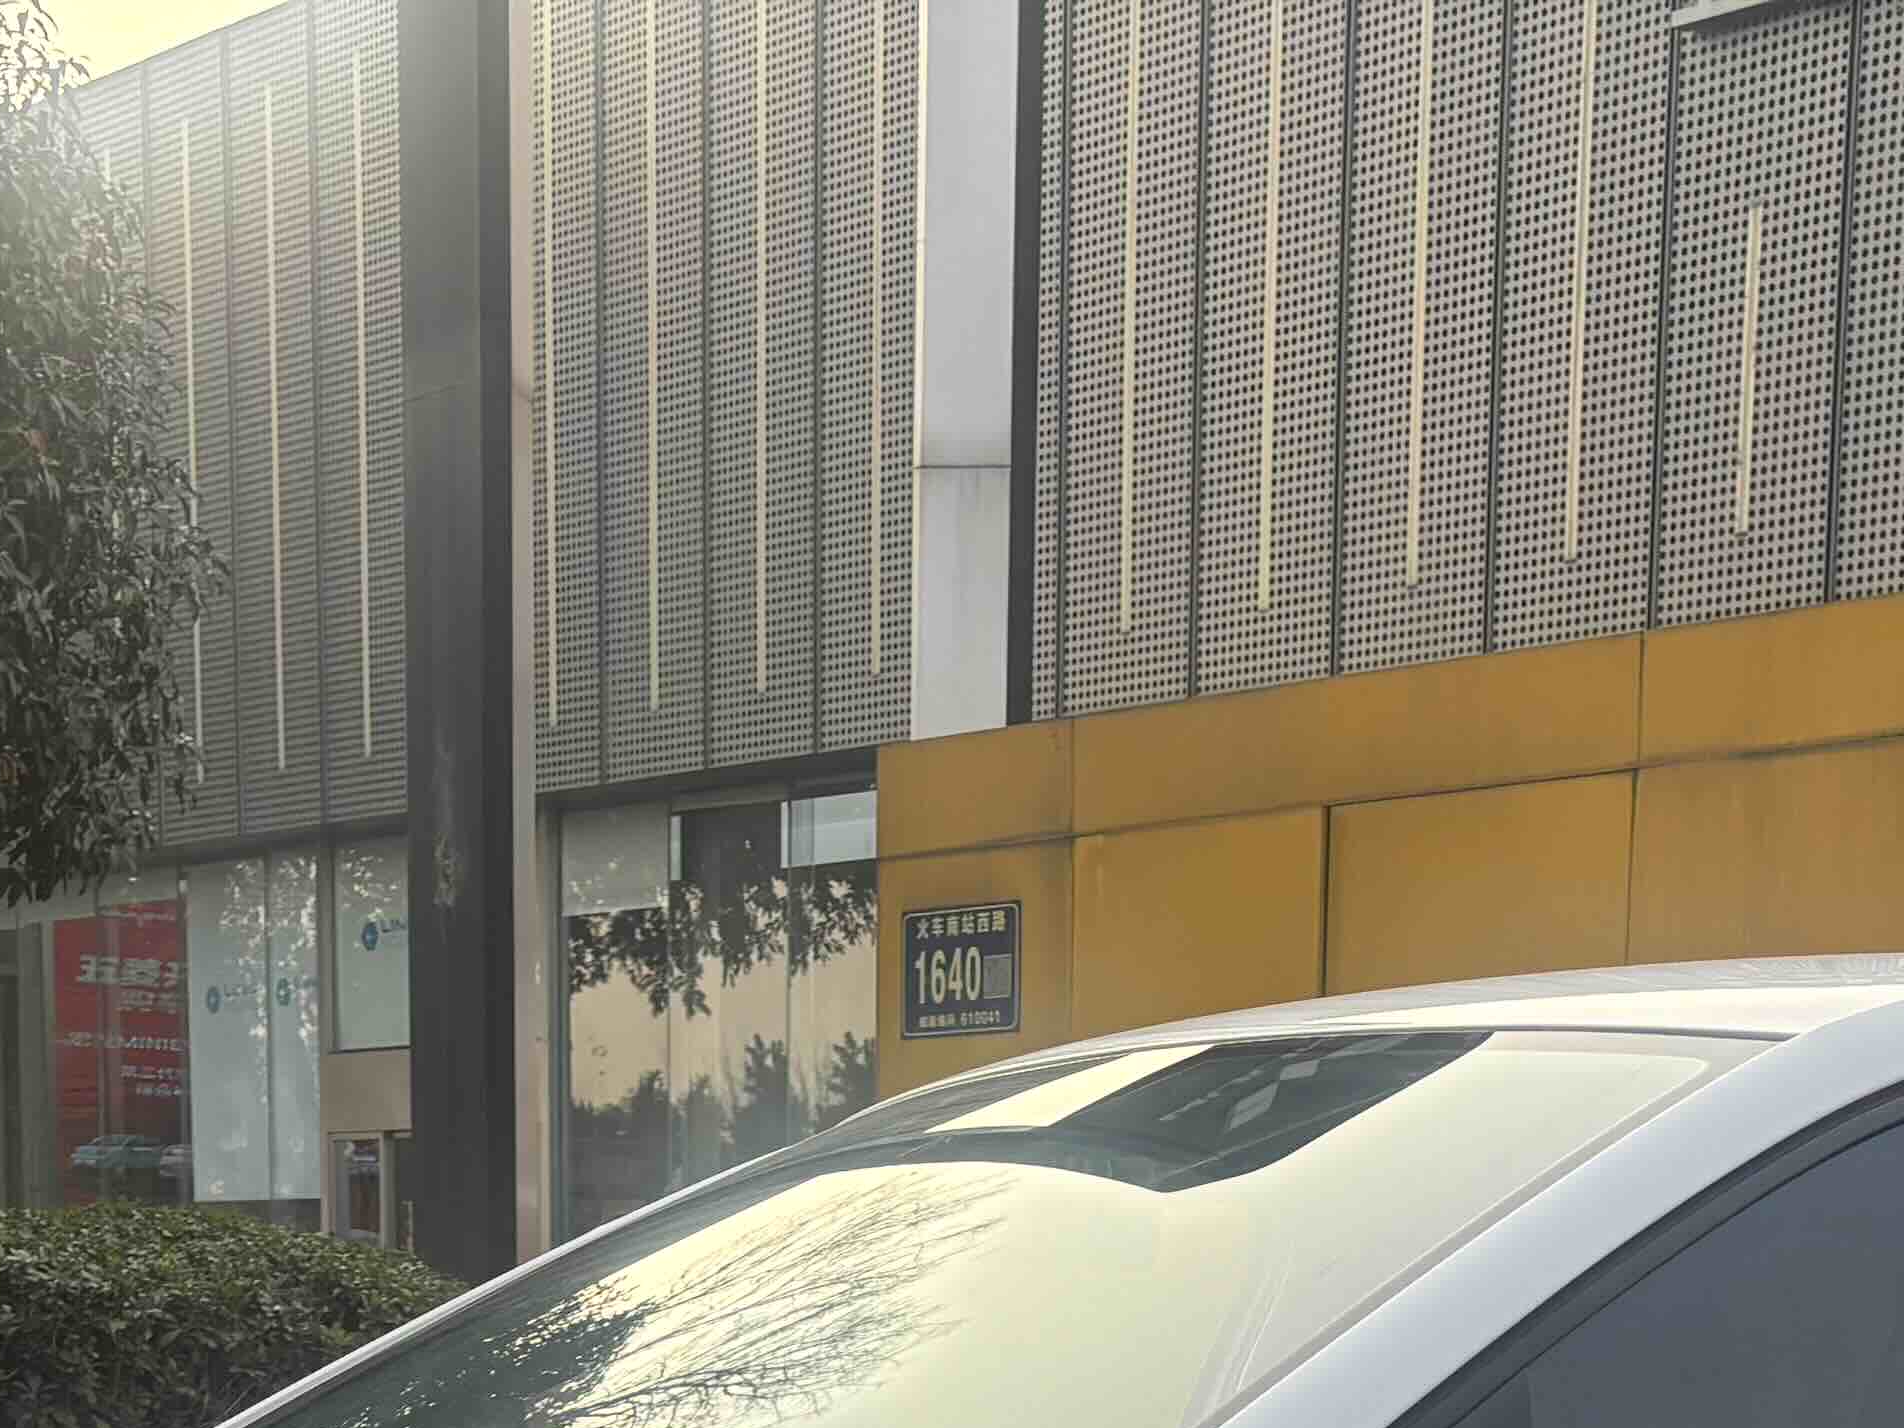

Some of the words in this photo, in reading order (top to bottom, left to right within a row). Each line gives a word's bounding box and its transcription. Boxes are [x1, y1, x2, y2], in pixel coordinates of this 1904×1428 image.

[915, 910, 1006, 940] 火车南站西路
[914, 946, 982, 1005] 1640
